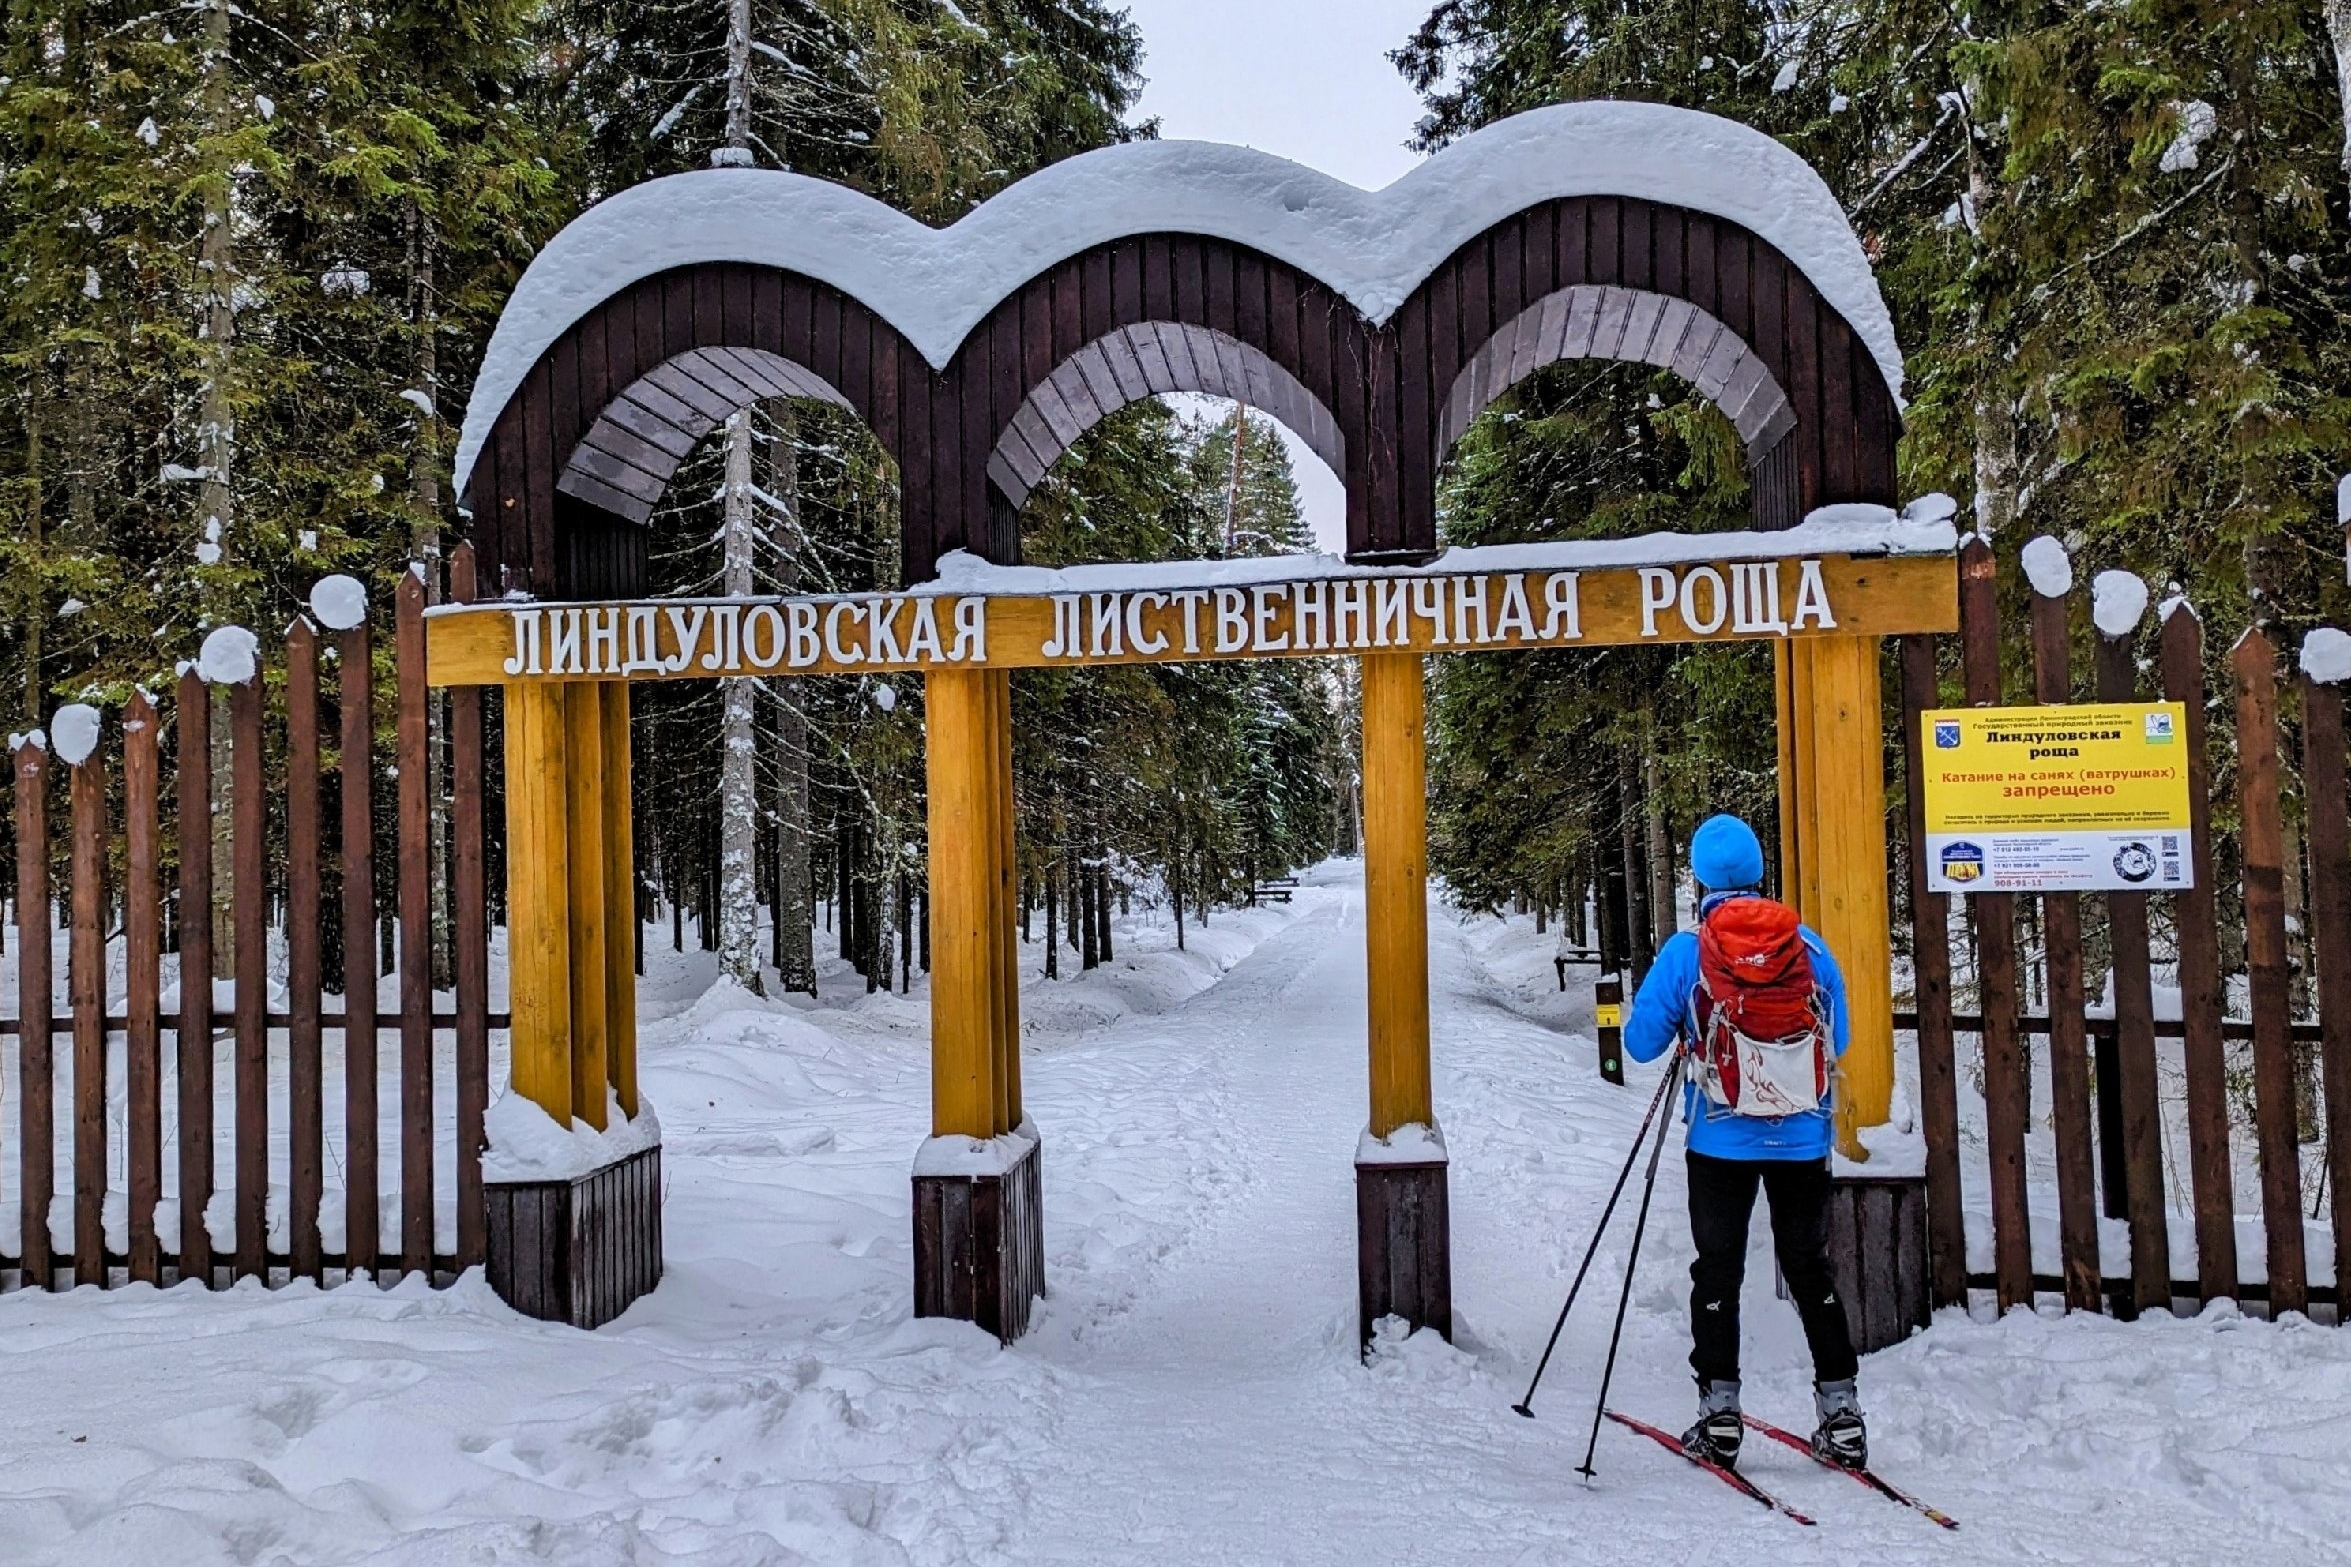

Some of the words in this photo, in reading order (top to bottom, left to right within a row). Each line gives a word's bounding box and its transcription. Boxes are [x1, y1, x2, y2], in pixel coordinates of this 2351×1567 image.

[504, 597, 987, 677] ЛИНДУЛОВСКАЯ
[1041, 572, 1583, 658] ЛИСТВЕННИЧНАЯ
[1637, 560, 1837, 637] РОЩА
[1986, 730, 2121, 744] Линдуловская
[2029, 747, 2079, 760] роща
[1942, 773, 2003, 783] Катание
[2008, 772, 2026, 781] на
[2030, 770, 2075, 781] санях
[2079, 767, 2176, 782] (ватрушках)
[2003, 783, 2115, 799] запрещено
[1994, 879, 2042, 888] 908-91-11
